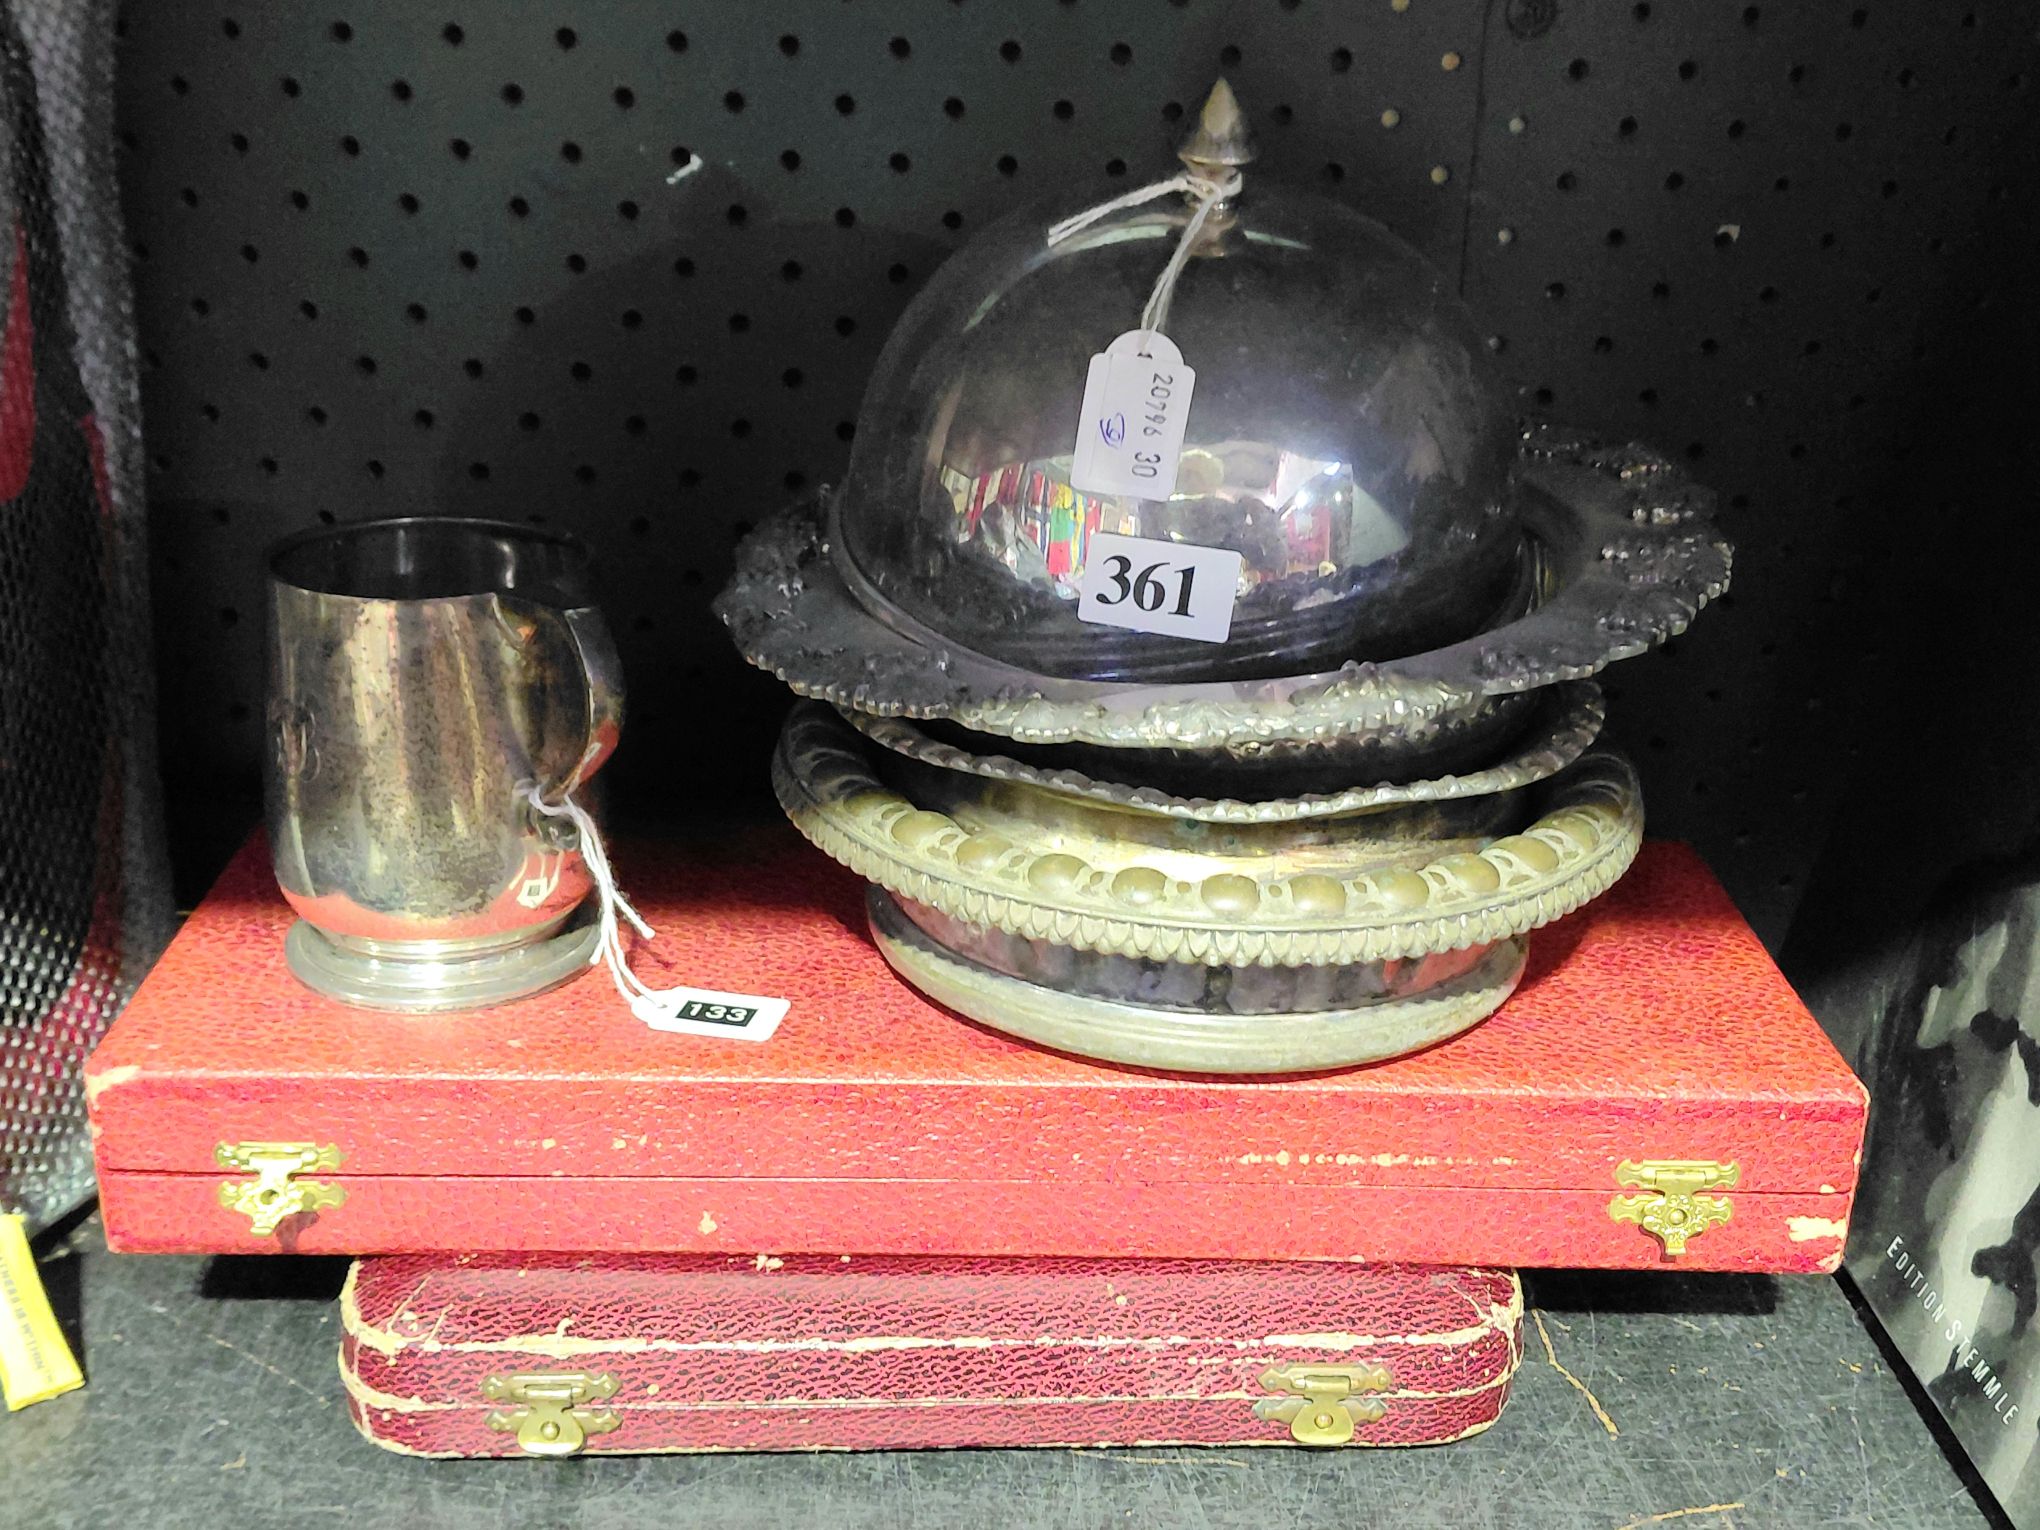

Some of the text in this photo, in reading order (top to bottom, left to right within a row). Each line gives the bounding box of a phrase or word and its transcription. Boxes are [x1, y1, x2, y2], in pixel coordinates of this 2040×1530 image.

[1131, 372, 1173, 478] 20796 30
[1096, 555, 1195, 618] 361
[688, 1003, 748, 1022] 133
[1886, 1235, 2018, 1425] EDITION STEMMLE
